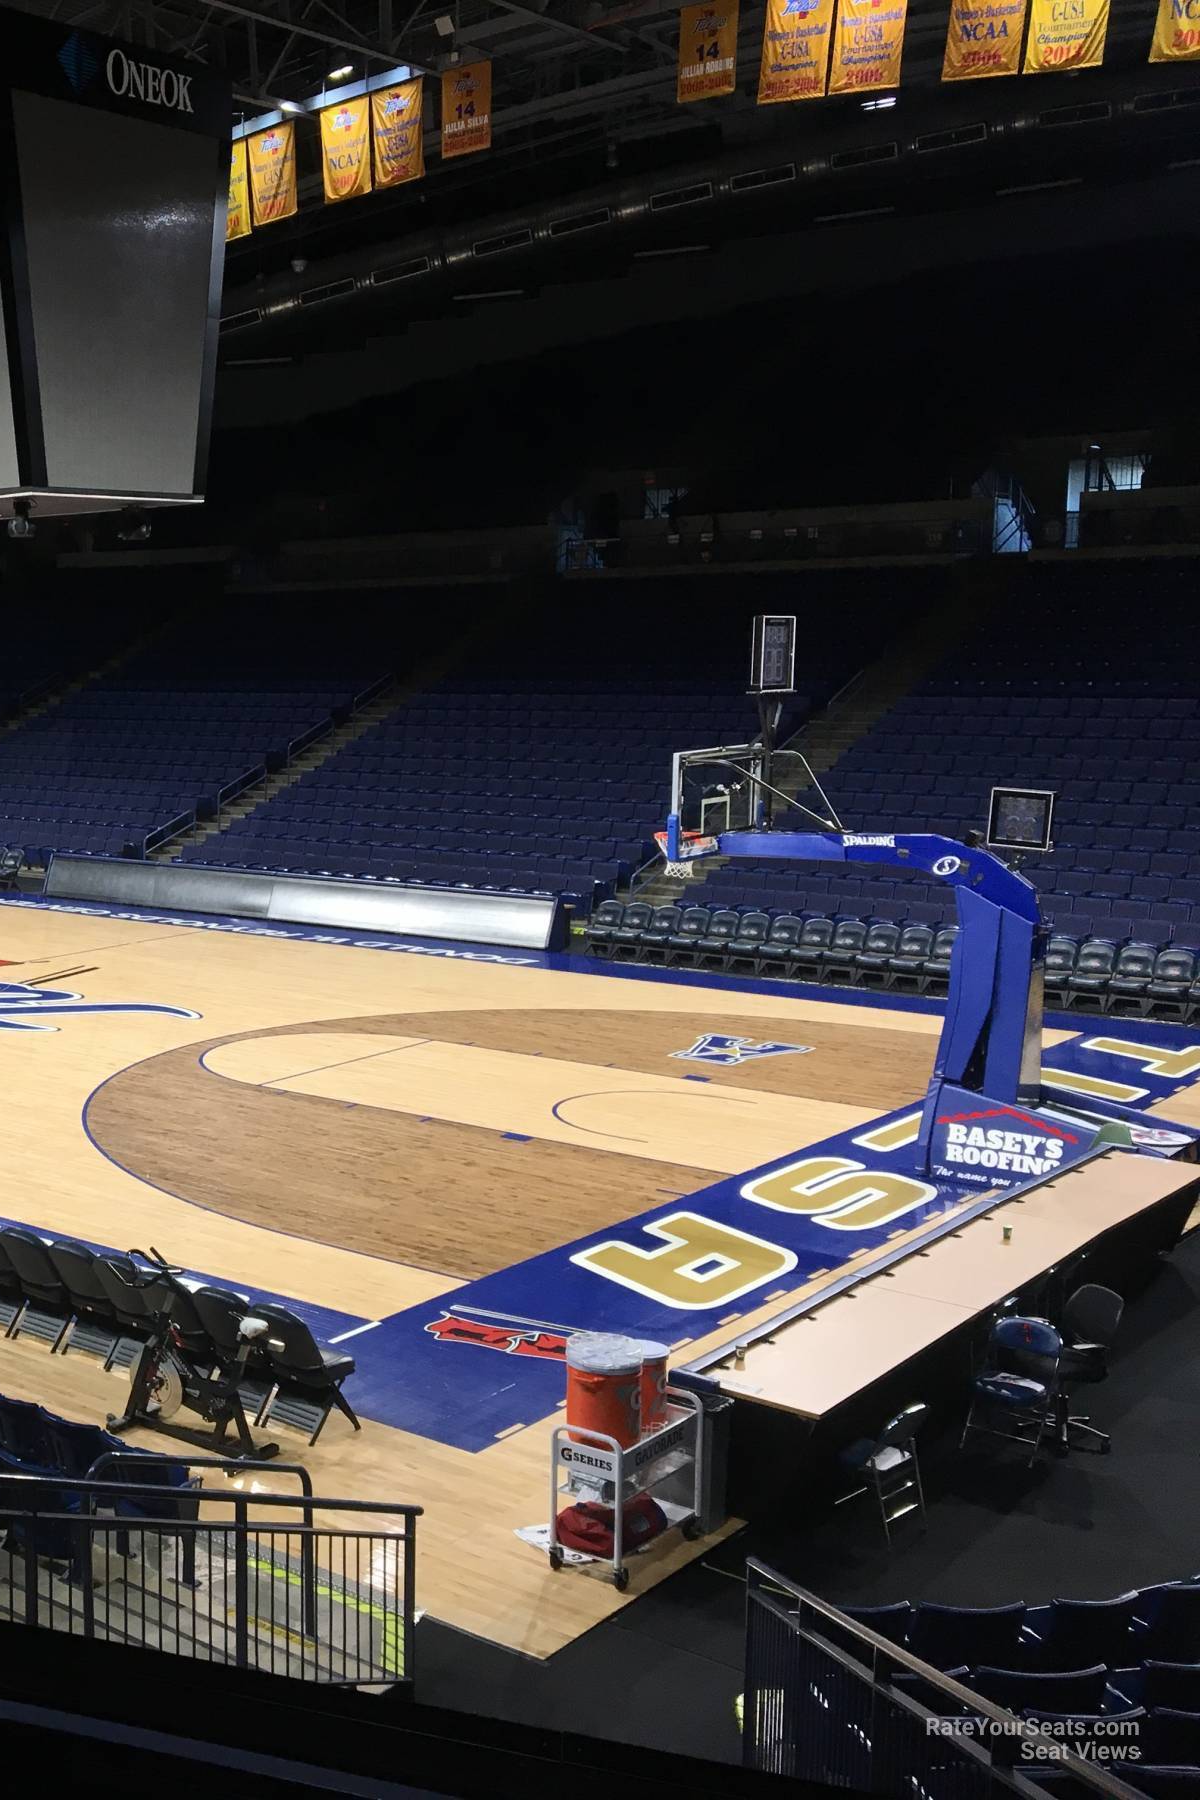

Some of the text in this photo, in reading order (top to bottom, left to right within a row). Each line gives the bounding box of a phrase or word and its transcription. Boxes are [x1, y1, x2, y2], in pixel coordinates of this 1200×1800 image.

[959, 20, 1008, 41] NCAA
[696, 41, 719, 61] 14
[106, 48, 197, 115] ONEOK
[456, 101, 475, 119] 14
[444, 114, 489, 134] JULIA SILVA
[330, 151, 361, 170] NCAA
[843, 835, 895, 847] SPALDING
[111, 912, 304, 938] REYNOLDS
[946, 1122, 1063, 1160] BASEY'S
[634, 1426, 684, 1466] GATORADE
[573, 1451, 613, 1472] SERIES
